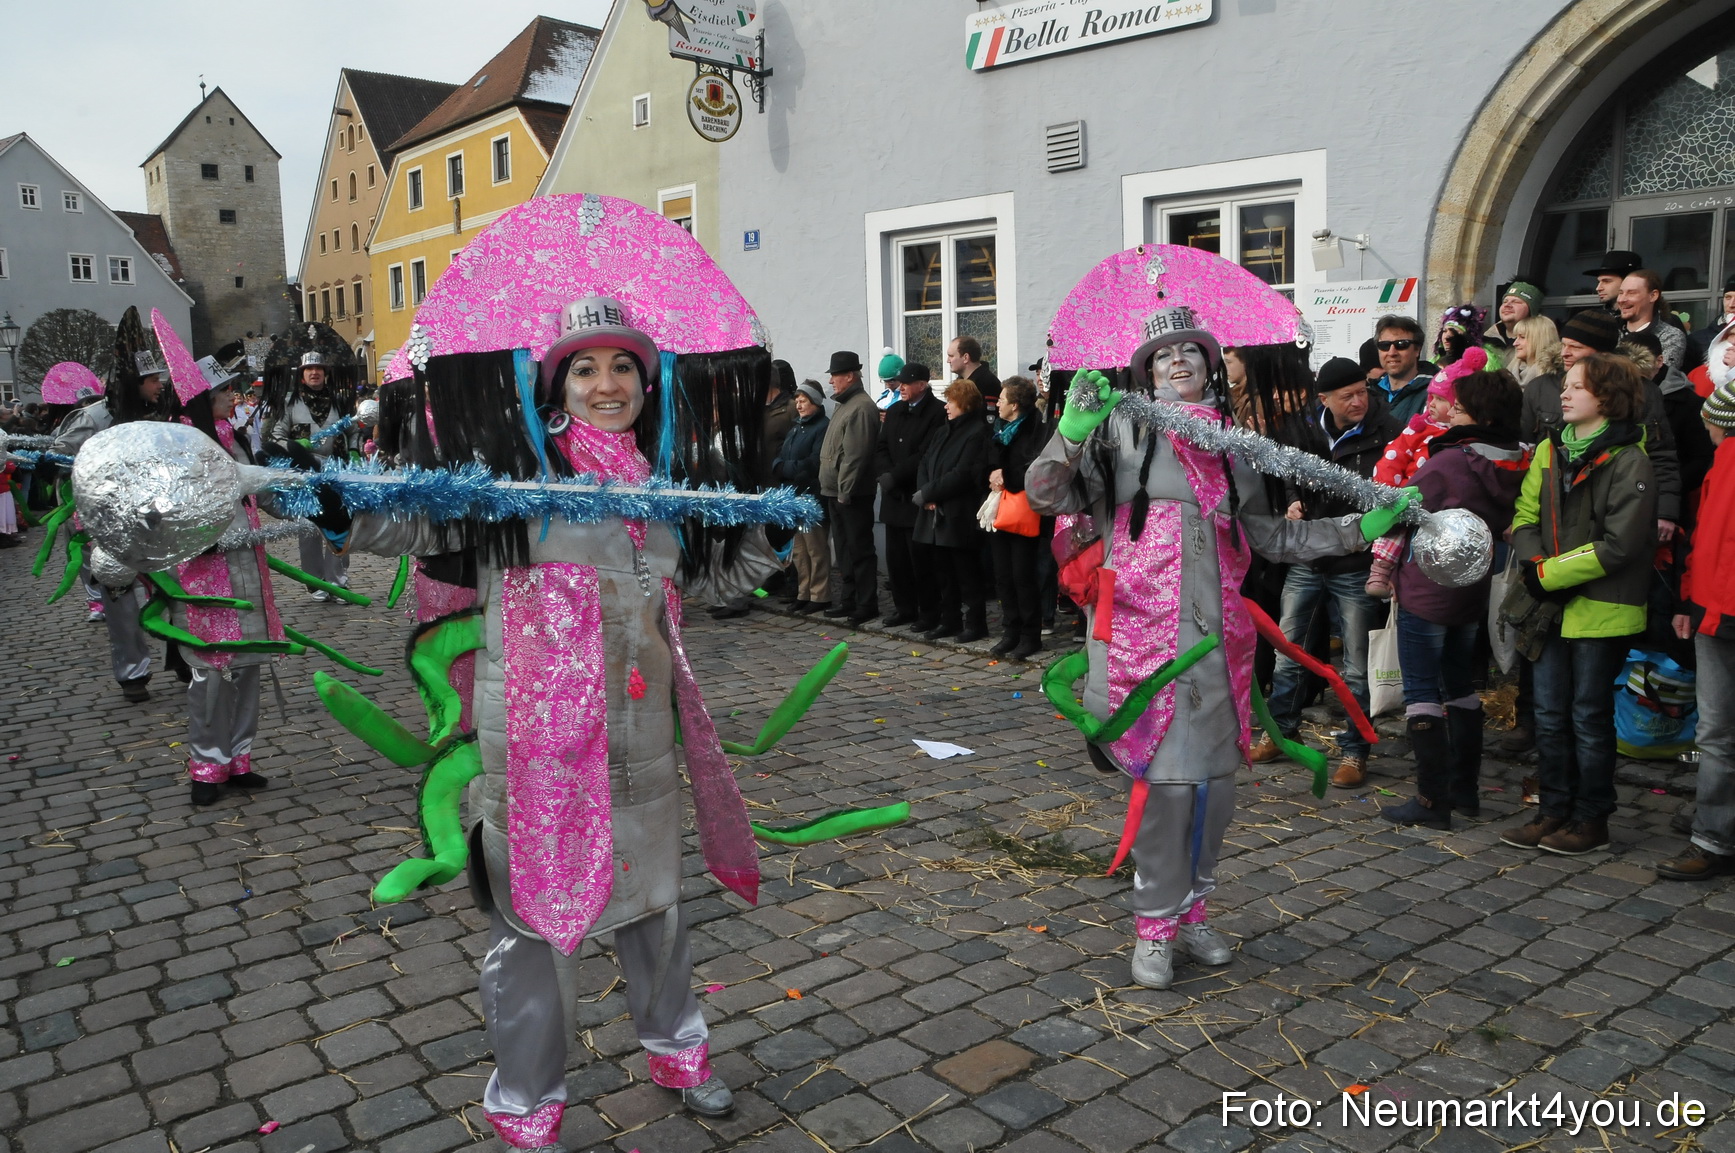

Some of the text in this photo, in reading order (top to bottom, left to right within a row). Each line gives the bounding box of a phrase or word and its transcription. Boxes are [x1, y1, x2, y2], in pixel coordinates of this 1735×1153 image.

[689, 5, 736, 26] Eisdiele
[1011, 1, 1056, 19] Pizzeria
[1002, 5, 1161, 55] Bella Roma
[675, 40, 712, 55] Roma
[698, 37, 730, 50] Bella
[748, 232, 755, 243] 19
[1313, 296, 1350, 305] Bella
[1327, 306, 1366, 315] Roma
